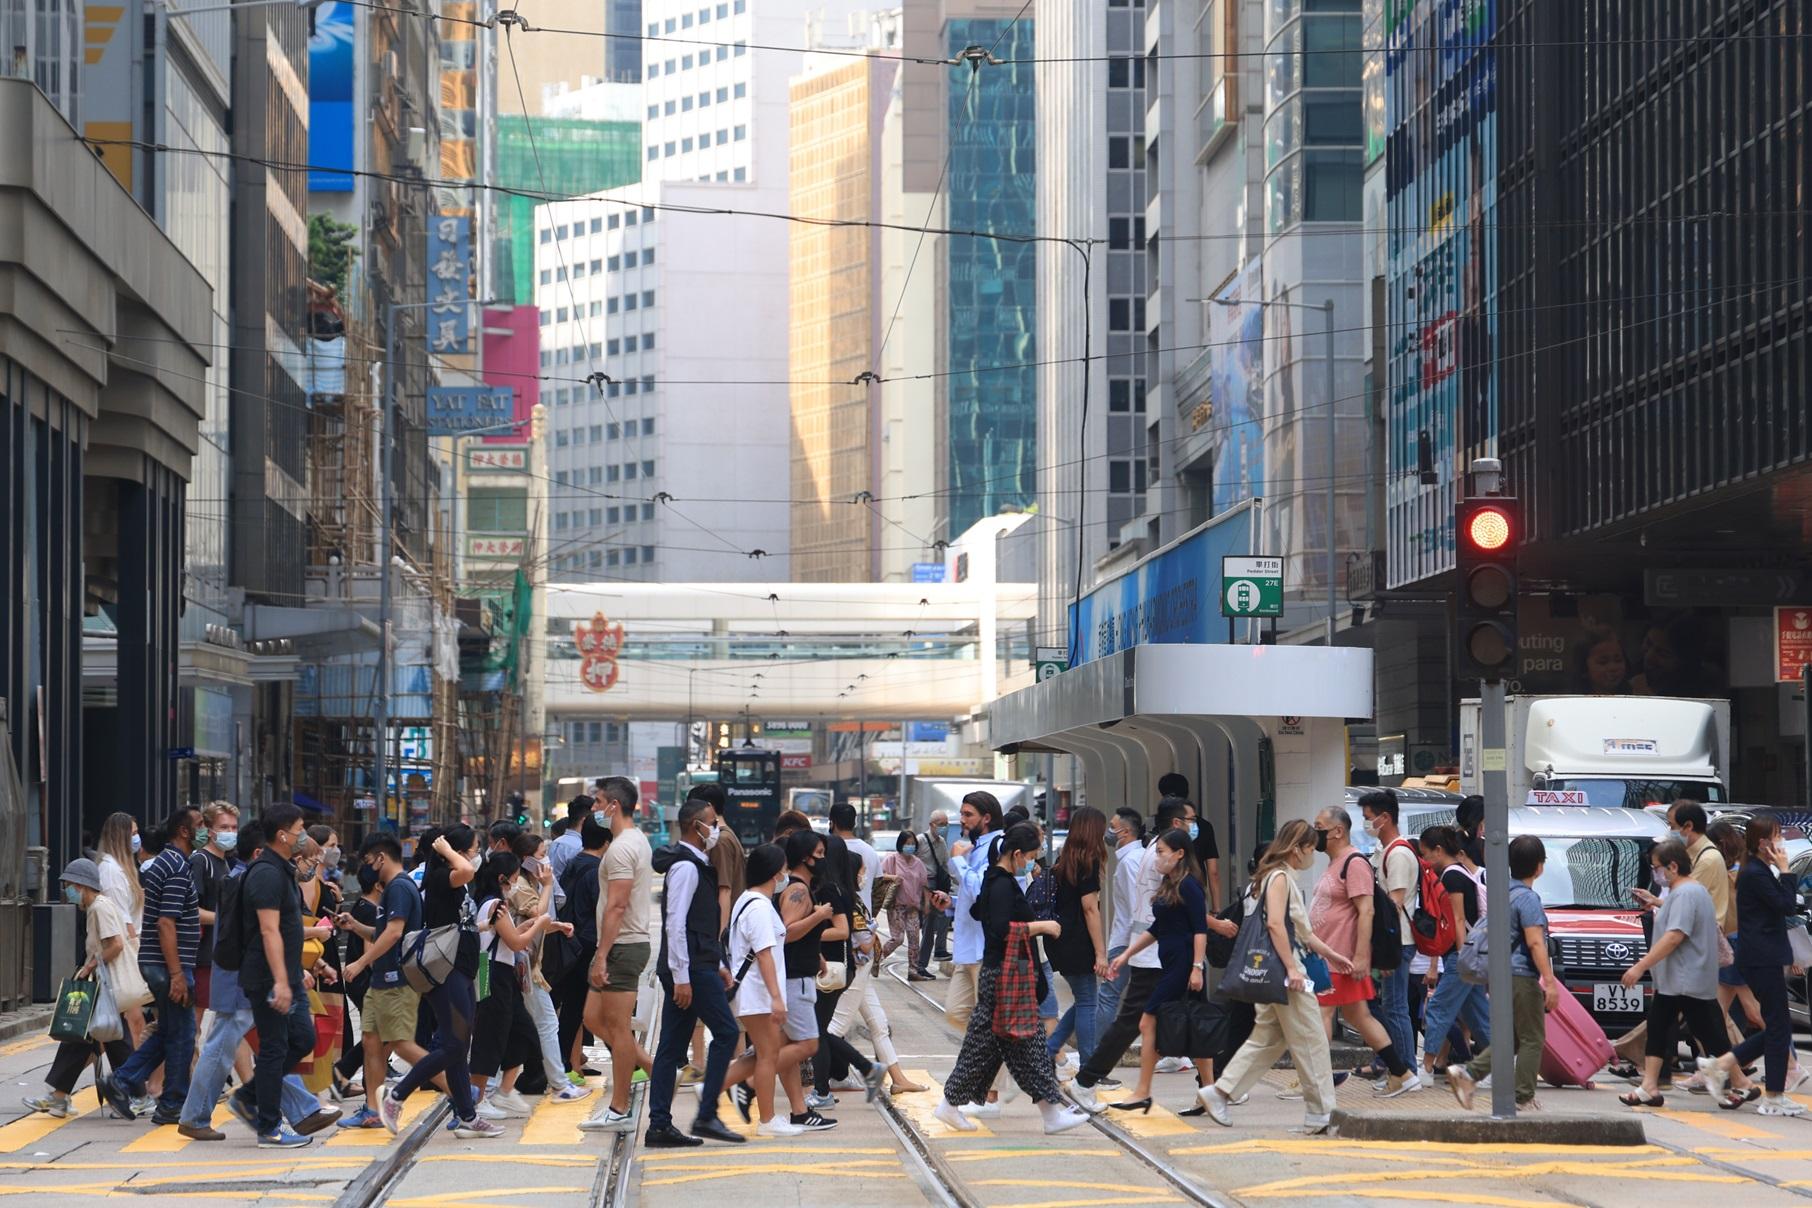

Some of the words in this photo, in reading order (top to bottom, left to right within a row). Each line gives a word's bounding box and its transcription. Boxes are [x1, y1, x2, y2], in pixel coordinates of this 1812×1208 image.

[432, 394, 466, 410] YAT
[1518, 633, 1565, 653] uting
[1523, 658, 1563, 674] para
[783, 758, 806, 767] KFC
[727, 788, 772, 796] Panasonic
[1534, 792, 1584, 804] TAXI
[1608, 985, 1628, 998] VY
[1597, 998, 1640, 1011] 8539
